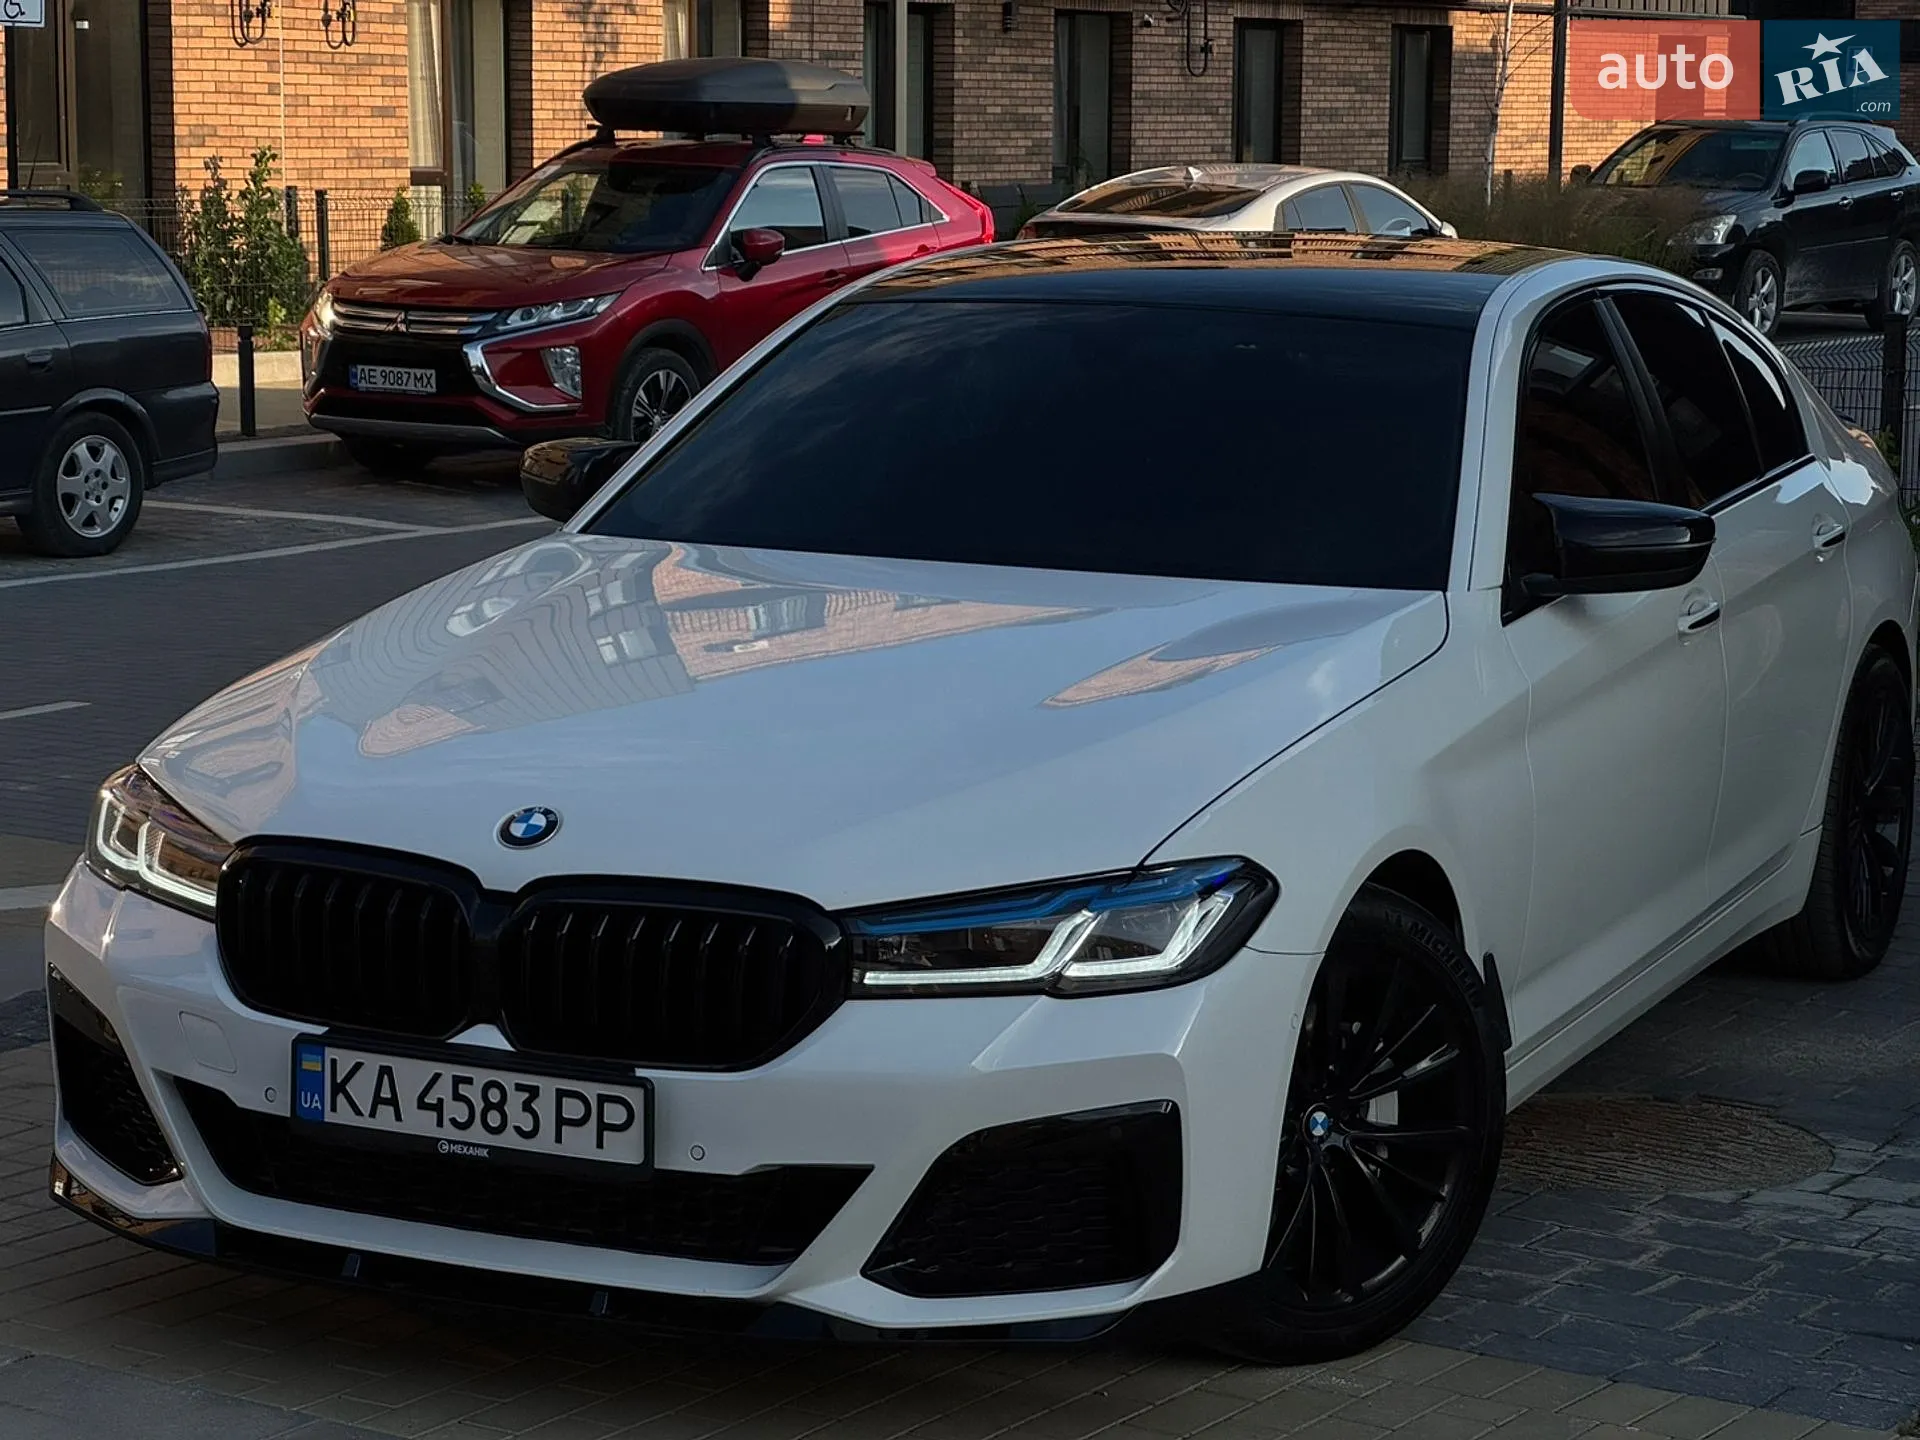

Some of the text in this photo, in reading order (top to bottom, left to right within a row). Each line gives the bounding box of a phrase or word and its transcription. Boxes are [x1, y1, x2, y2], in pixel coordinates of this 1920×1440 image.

[358, 368, 434, 389] AE 9087 MX
[301, 1091, 322, 1111] UA
[329, 1056, 637, 1150] KA 4583 PP
